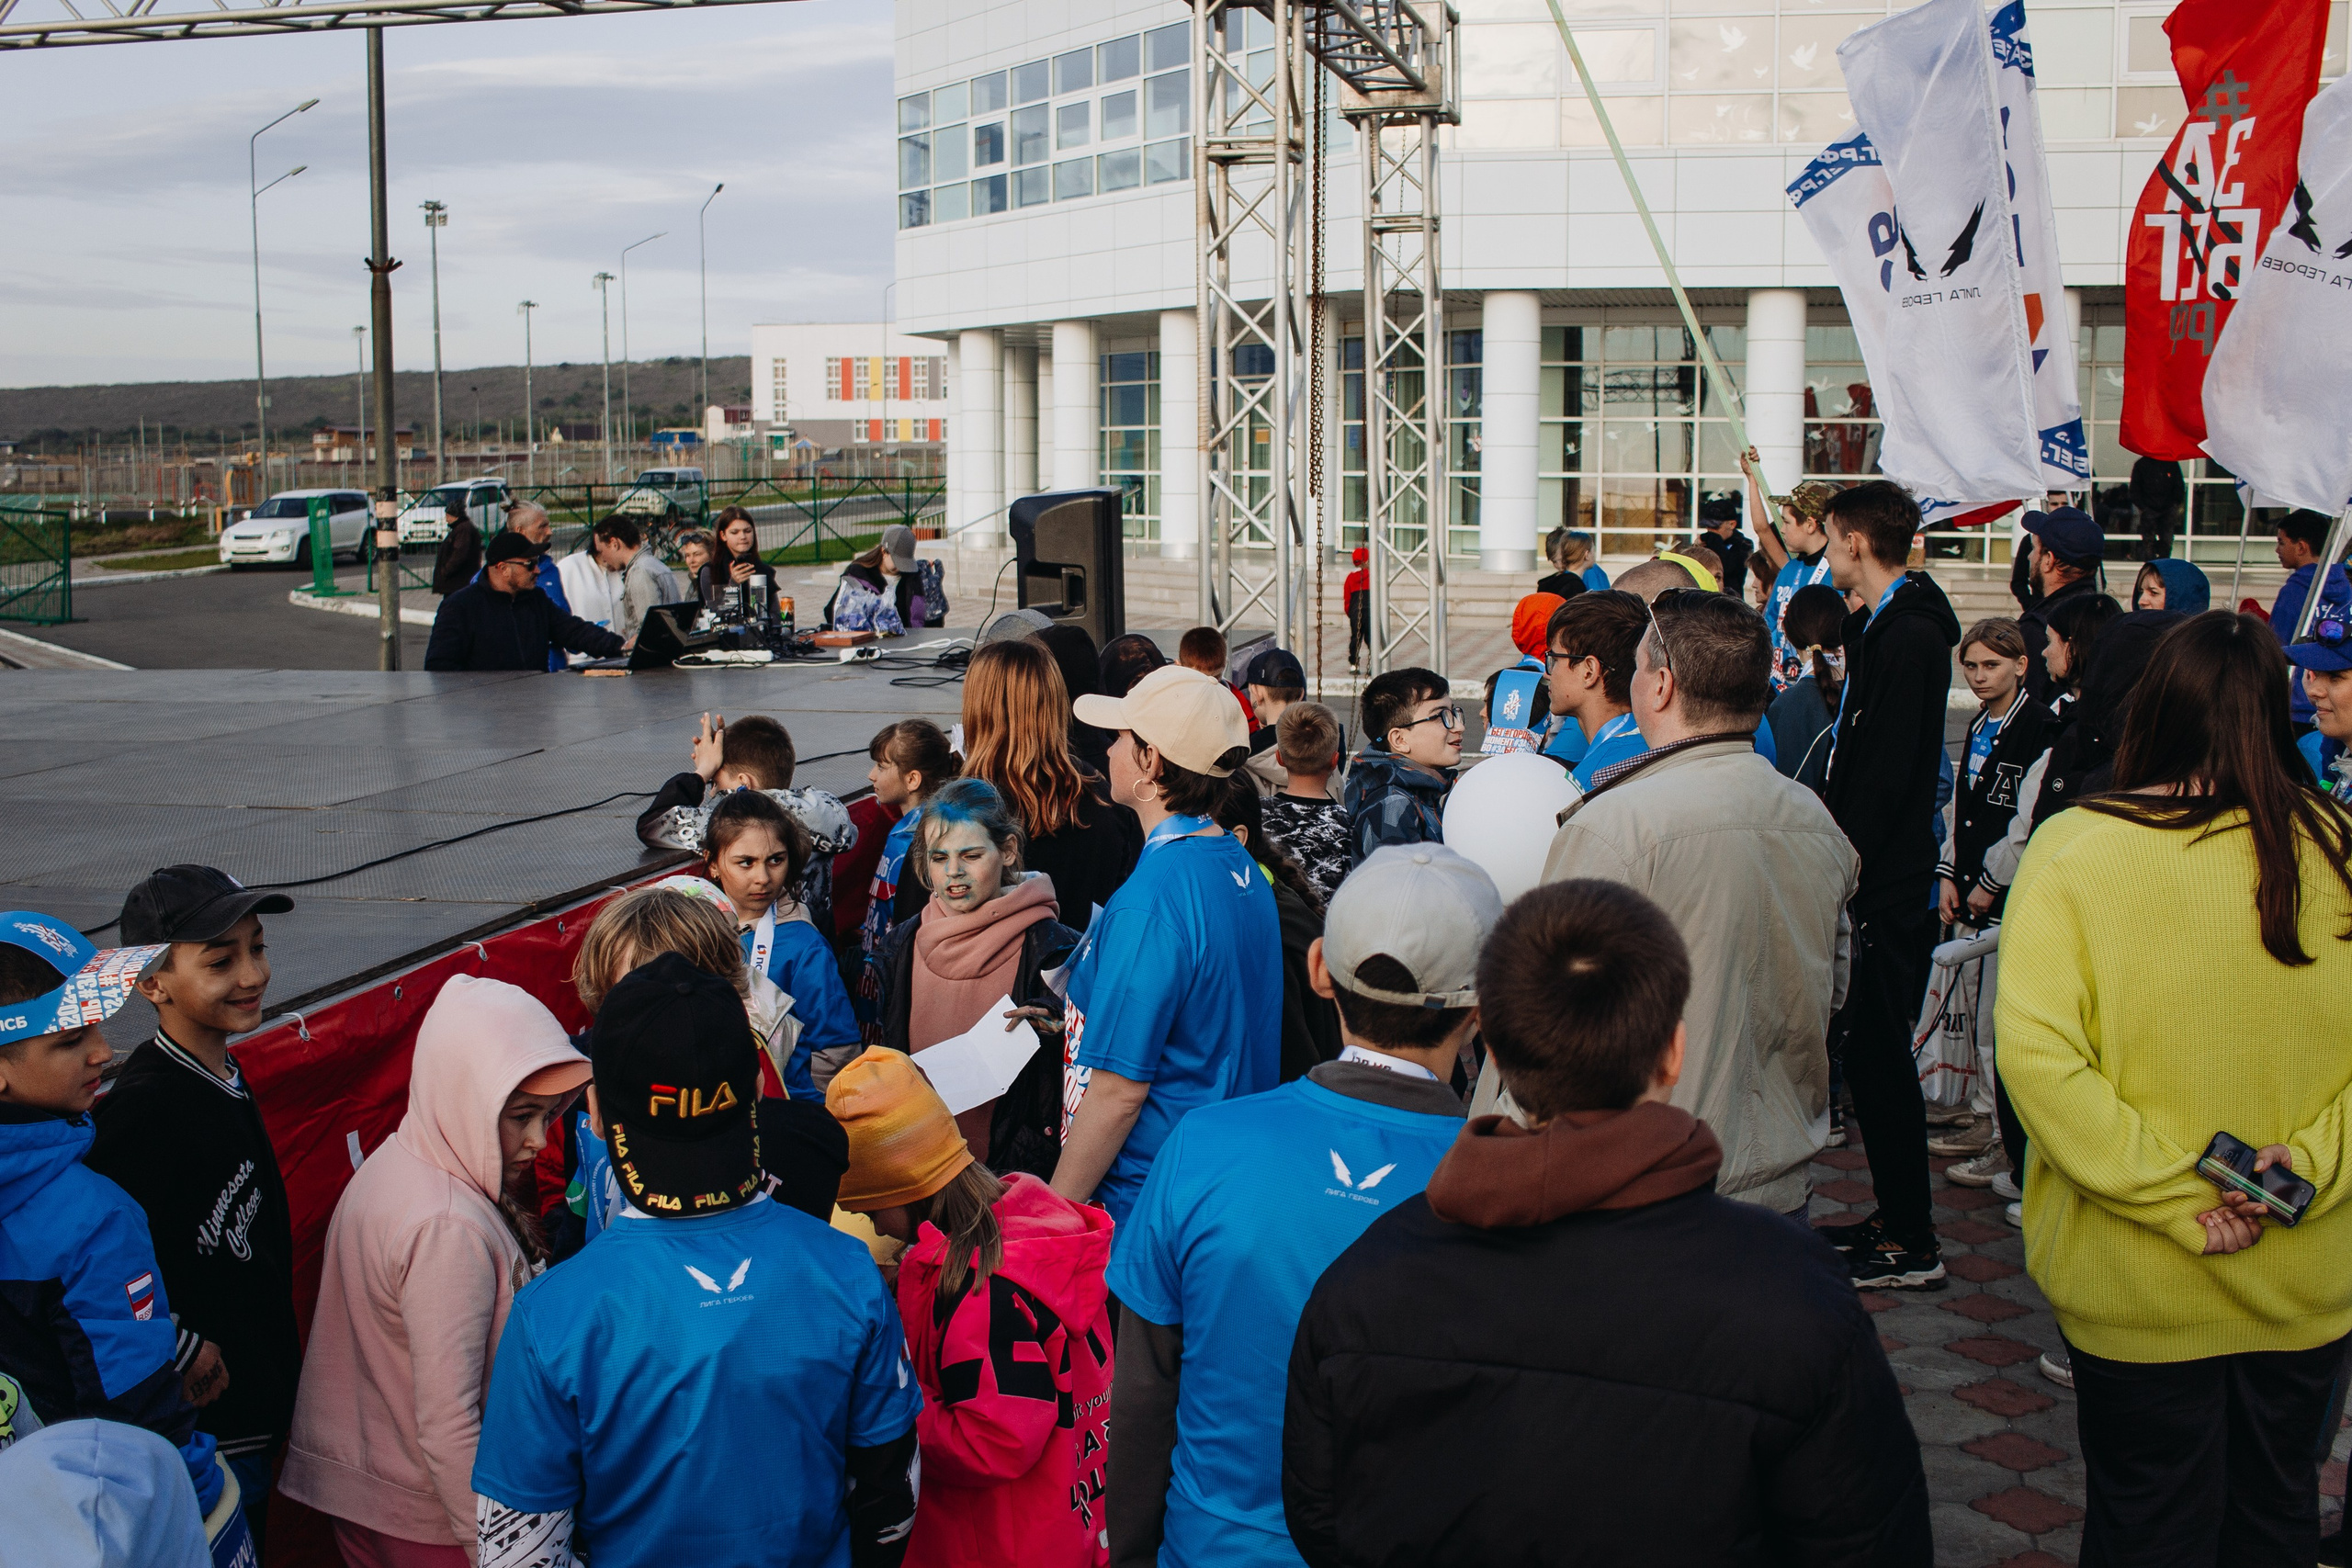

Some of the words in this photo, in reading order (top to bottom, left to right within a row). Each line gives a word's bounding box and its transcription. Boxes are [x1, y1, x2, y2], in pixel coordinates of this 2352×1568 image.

[650, 1081, 738, 1118] FILA
[612, 1122, 629, 1158] FILA
[621, 1161, 644, 1195] FILA
[738, 1174, 759, 1198] FILA
[198, 1160, 254, 1256] Minnesota
[647, 1193, 682, 1211] FILA
[695, 1191, 731, 1209] FILA
[1325, 1187, 1347, 1198] ЛИГА
[1349, 1192, 1380, 1206] ГЕРОЕВ
[226, 1187, 263, 1261] College
[699, 1299, 722, 1309] ЛИГА
[723, 1293, 754, 1304] ГЕРОЕВ
